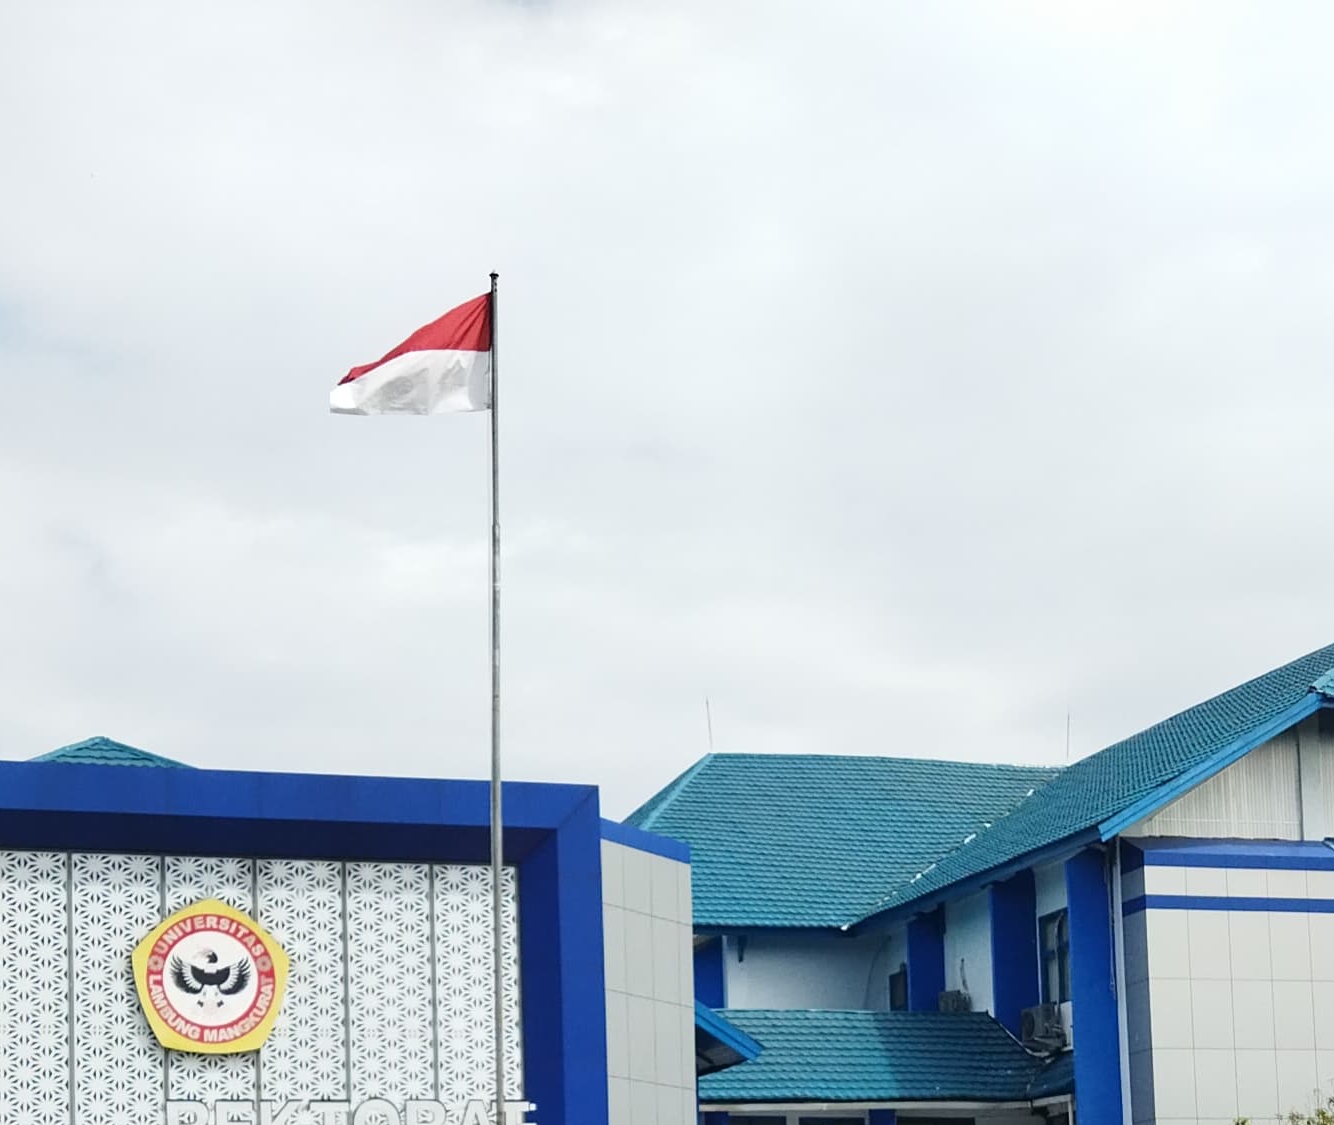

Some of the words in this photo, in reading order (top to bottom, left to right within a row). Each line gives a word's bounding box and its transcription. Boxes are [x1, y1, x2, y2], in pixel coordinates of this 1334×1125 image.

[158, 916, 265, 955] UNIVERSITAS
[149, 974, 200, 1039] LAMBUNG
[203, 975, 273, 1042] MANGKURAT
